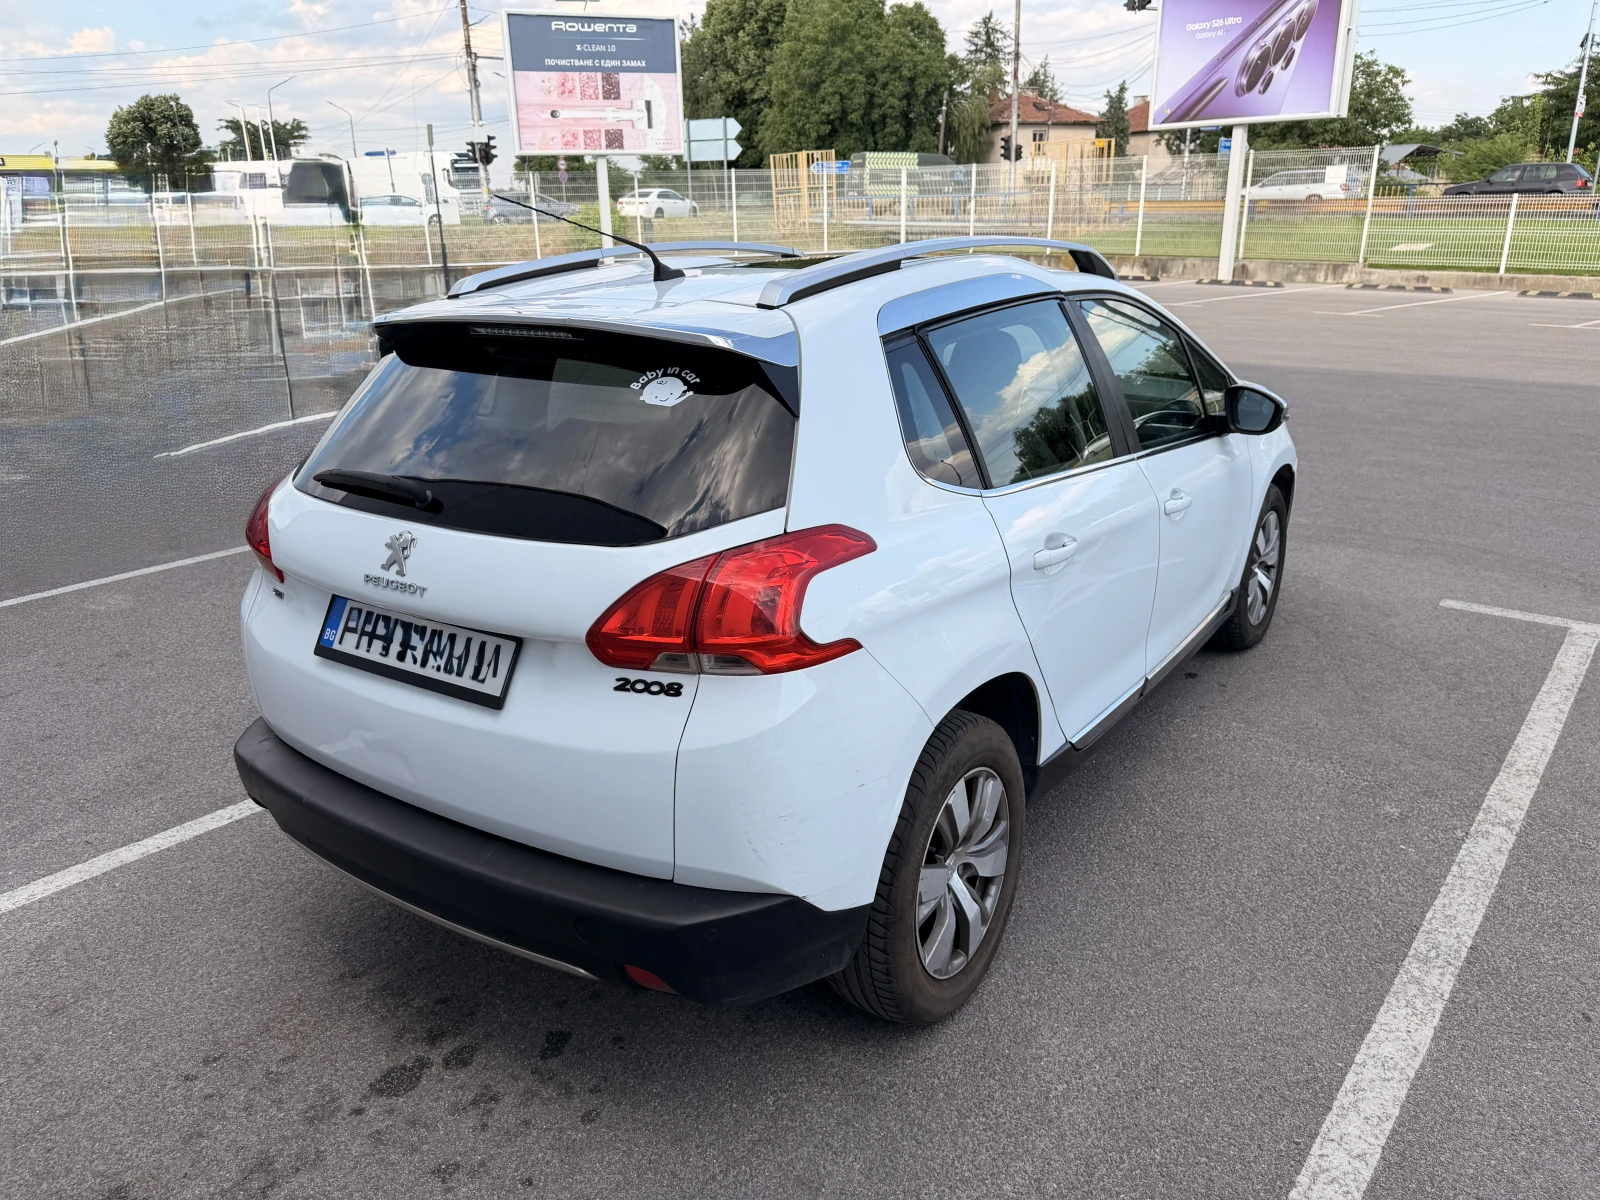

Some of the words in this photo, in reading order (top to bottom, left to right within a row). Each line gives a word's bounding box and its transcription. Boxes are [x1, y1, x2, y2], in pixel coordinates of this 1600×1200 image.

[551, 21, 637, 33] Rowenta
[1186, 22, 1211, 31] Galaxy
[1211, 19, 1223, 27] S26
[1225, 17, 1242, 25] Ultra
[1195, 31, 1216, 39] Galaxy
[576, 44, 606, 52] X-CLEAN
[607, 44, 616, 52] 10
[545, 58, 593, 66] ПОЧИСТВАНЕ
[594, 59, 600, 67] С
[600, 59, 621, 68] ЕДИН
[621, 59, 646, 68] ЗАМАХ
[629, 368, 664, 390] Baby
[667, 366, 680, 375] in
[681, 370, 701, 384] car
[363, 573, 428, 597] PEUGEOT
[323, 627, 336, 641] BG
[612, 677, 684, 697] 2008
